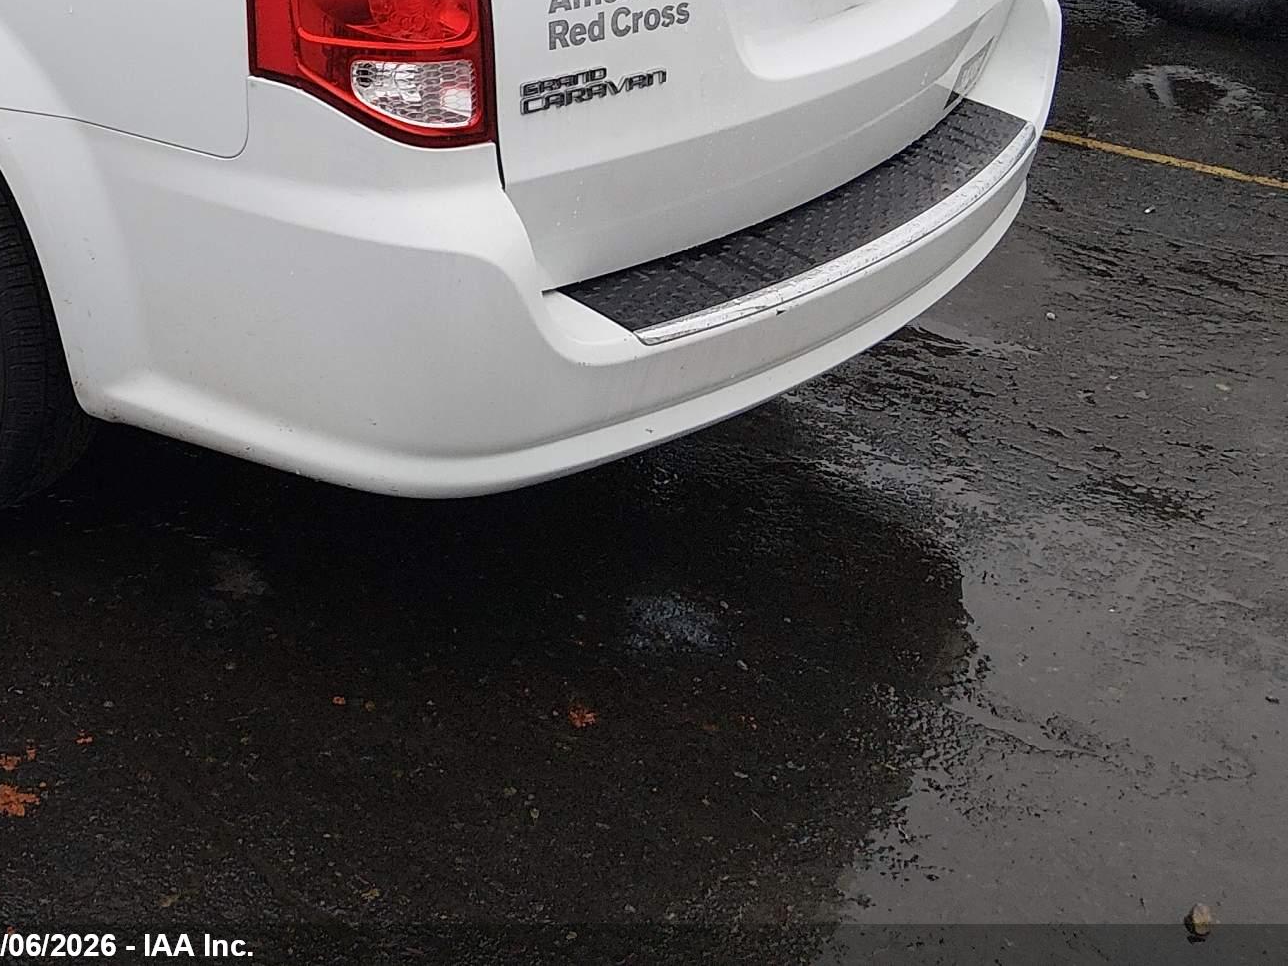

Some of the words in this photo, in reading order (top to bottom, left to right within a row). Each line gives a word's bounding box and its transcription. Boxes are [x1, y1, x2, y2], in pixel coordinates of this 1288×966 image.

[548, 11, 605, 51] Red
[612, 2, 690, 37] Cross
[520, 66, 608, 98] GRAND
[520, 68, 668, 116] CARAVAN
